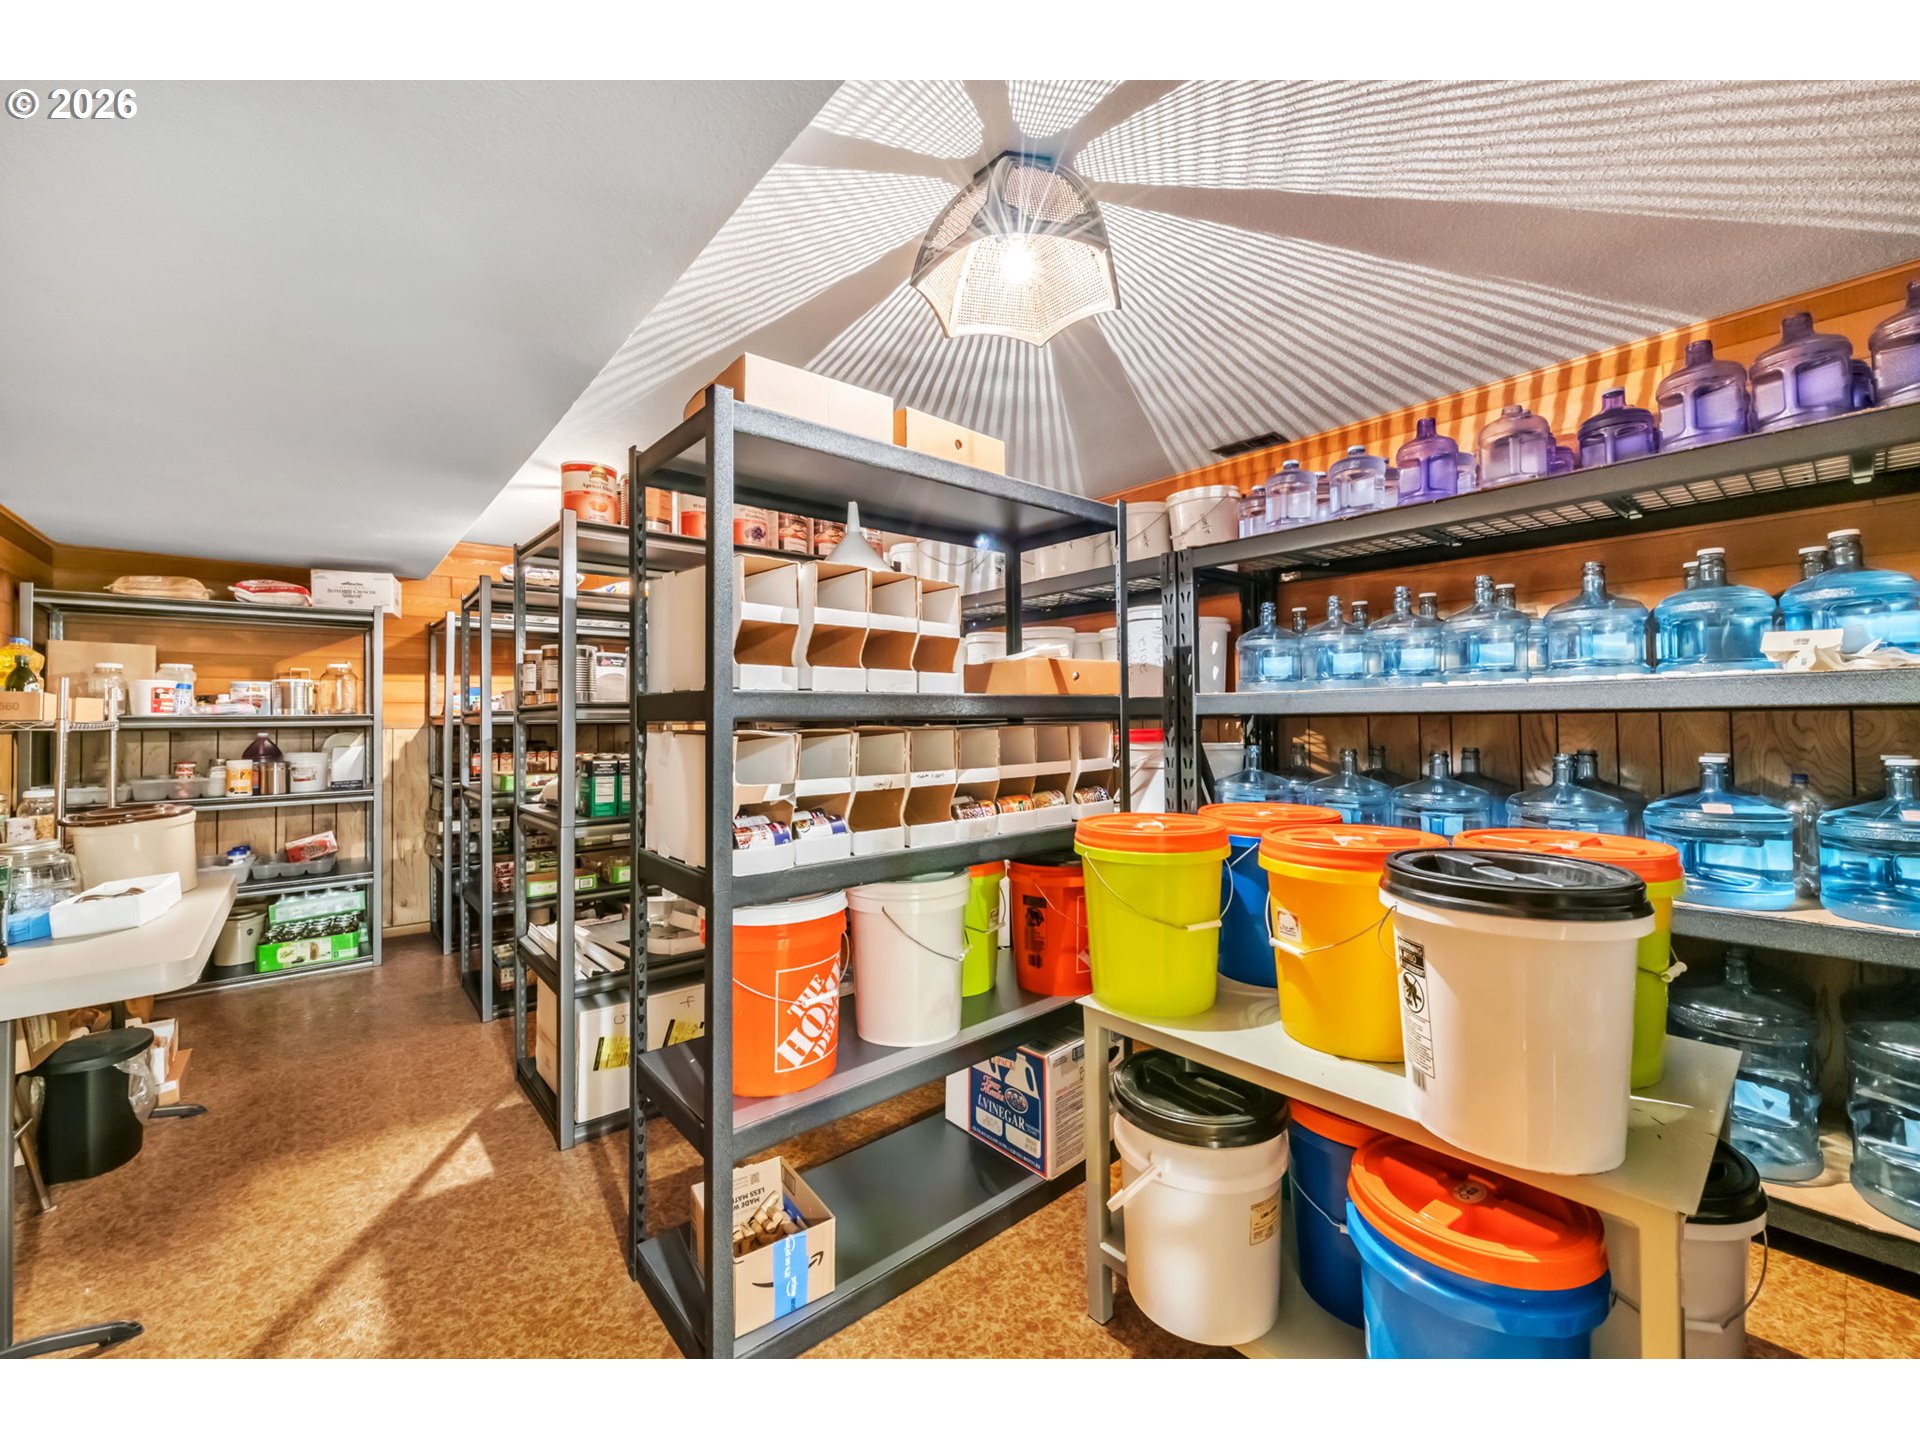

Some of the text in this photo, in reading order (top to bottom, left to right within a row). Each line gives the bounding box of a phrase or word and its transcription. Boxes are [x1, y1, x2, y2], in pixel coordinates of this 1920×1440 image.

[787, 974, 825, 1016] THE
[979, 1094, 1025, 1131] VINEGAR
[740, 1196, 760, 1210] MADE
[749, 1186, 766, 1198] LESS
